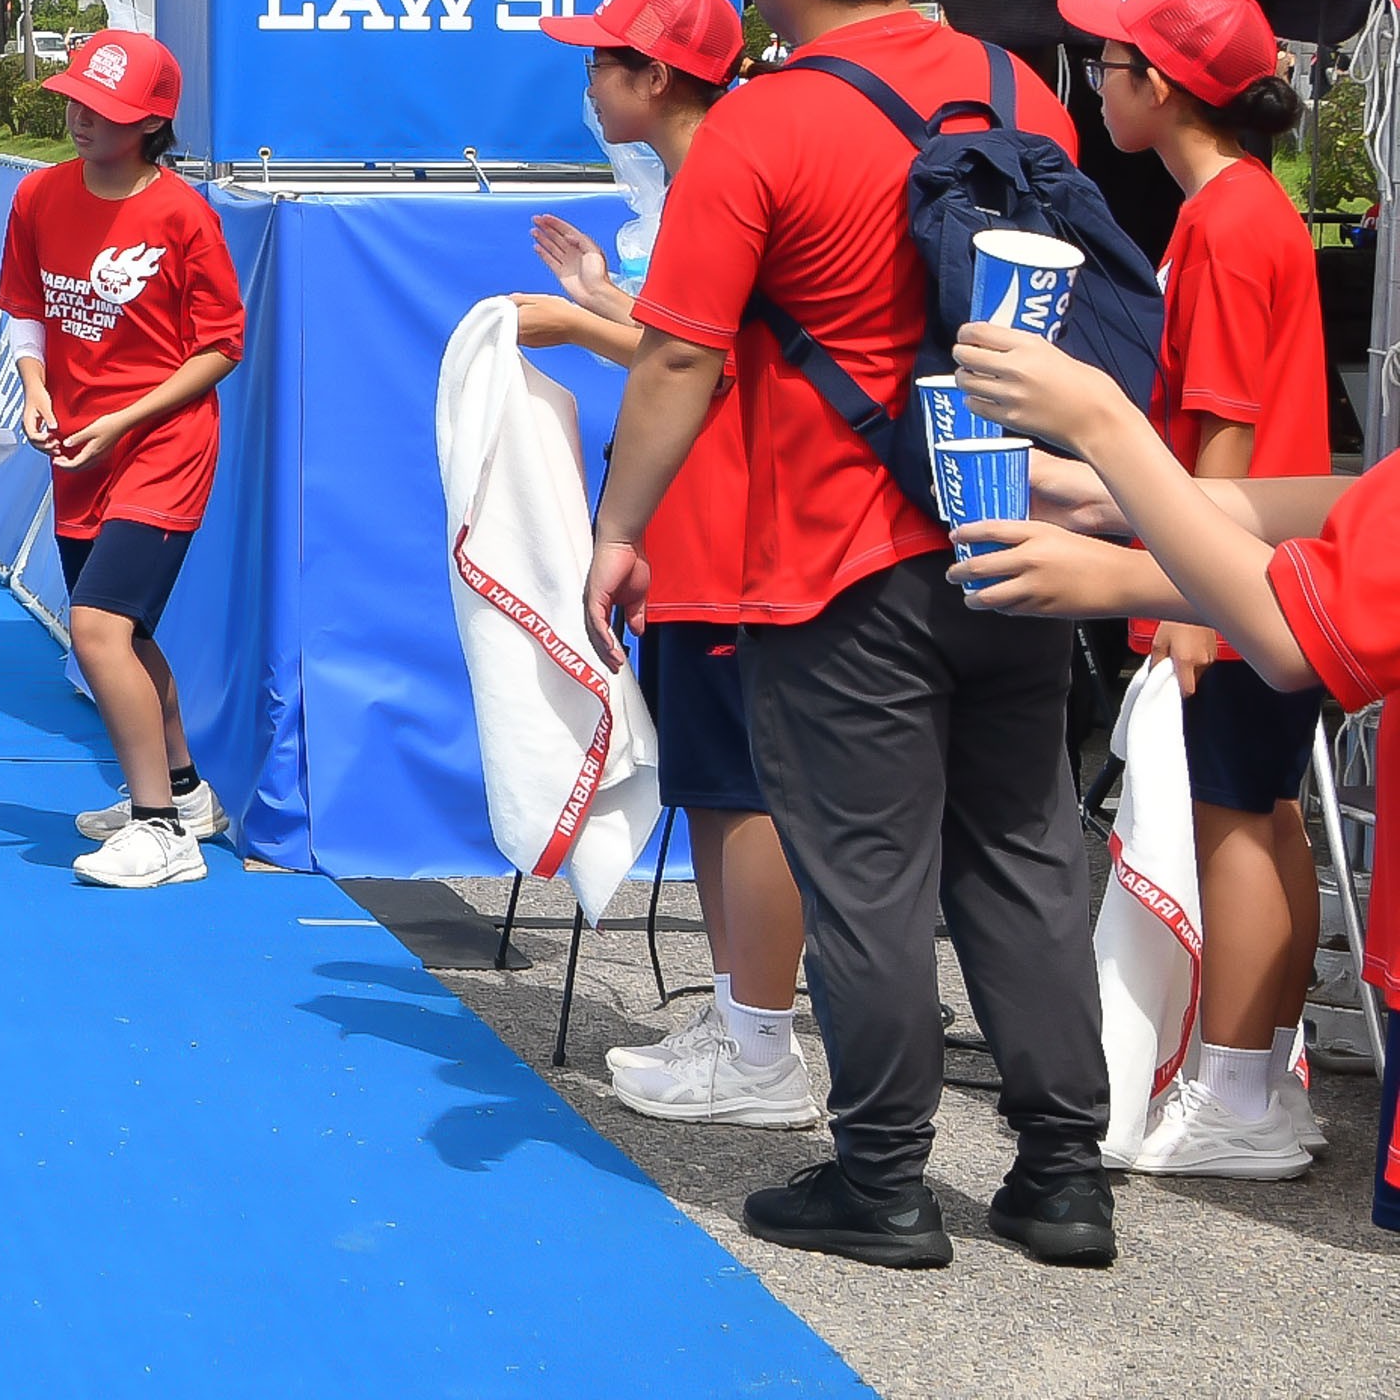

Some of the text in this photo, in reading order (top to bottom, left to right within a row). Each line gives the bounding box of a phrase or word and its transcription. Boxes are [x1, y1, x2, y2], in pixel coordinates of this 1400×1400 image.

[40, 268, 92, 295] ABARI
[44, 287, 125, 316] KATAJIMA
[45, 304, 117, 330] IATHLON
[61, 319, 104, 342] 2025
[487, 585, 587, 677] HAKATAJIMA
[556, 756, 601, 838] IMABARI
